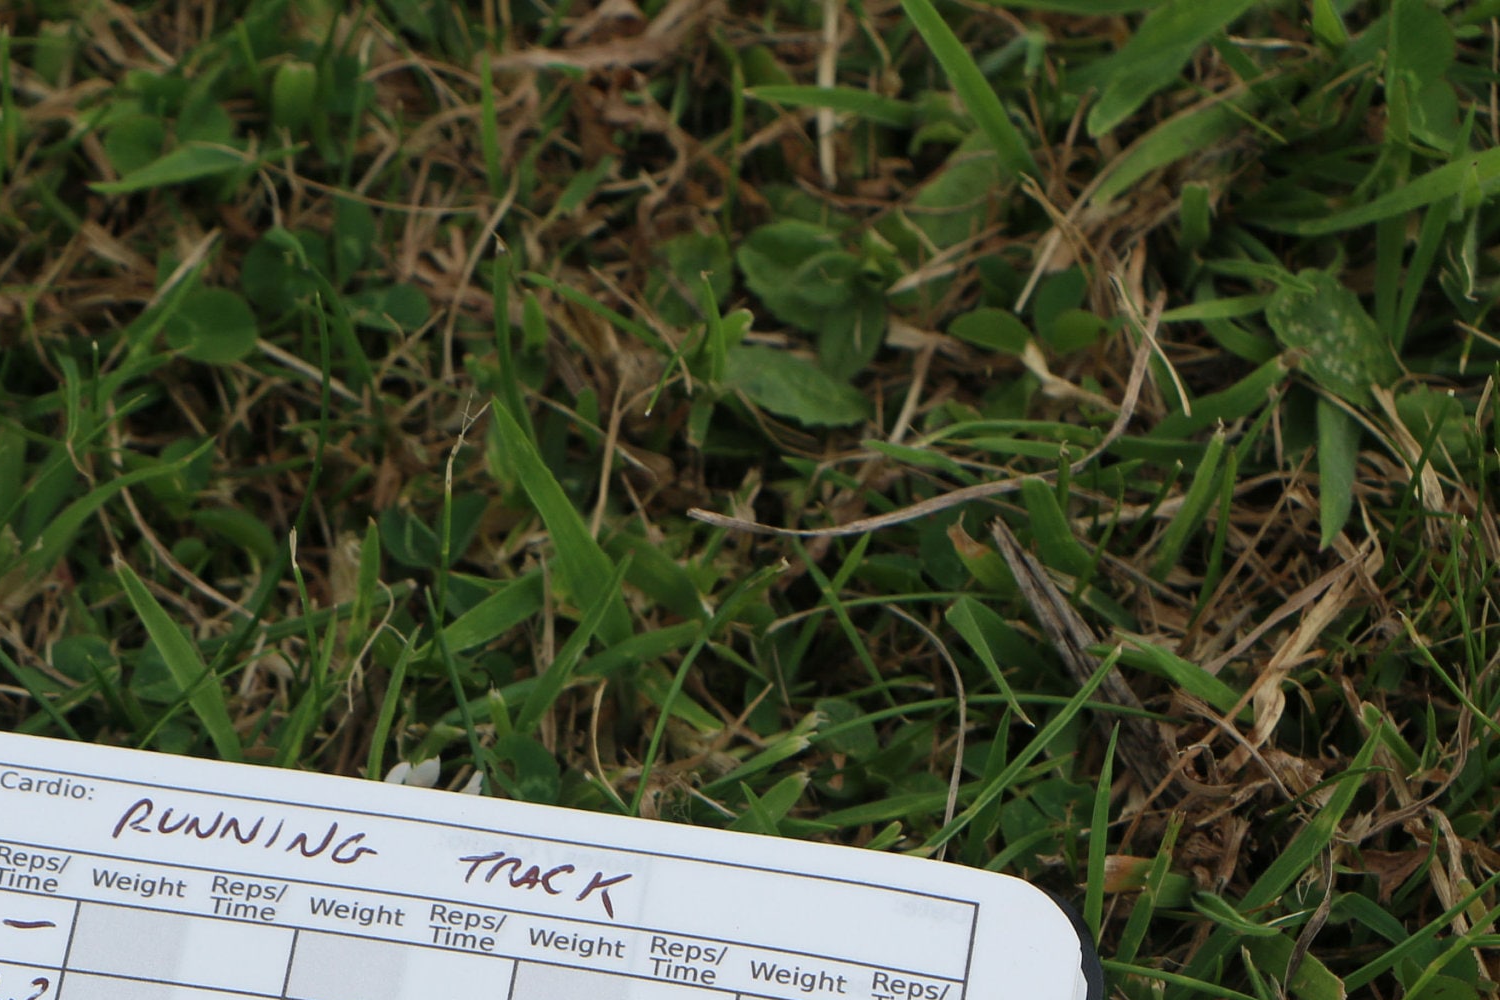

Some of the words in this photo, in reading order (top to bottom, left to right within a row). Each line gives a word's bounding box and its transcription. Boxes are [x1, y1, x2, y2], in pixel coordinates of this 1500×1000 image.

[0, 770, 94, 801] Cardio:
[112, 798, 377, 864] RUNNING
[459, 852, 632, 919] TRACK
[92, 868, 187, 899] Weight
[211, 874, 289, 904] Reps/
[210, 896, 276, 923] Time
[309, 897, 406, 928] Weight
[429, 904, 507, 933] Reps/
[428, 926, 495, 952] Time
[528, 928, 626, 960] Weight
[650, 935, 728, 966] Reps/
[649, 958, 716, 986] Time
[750, 960, 847, 994] Weight
